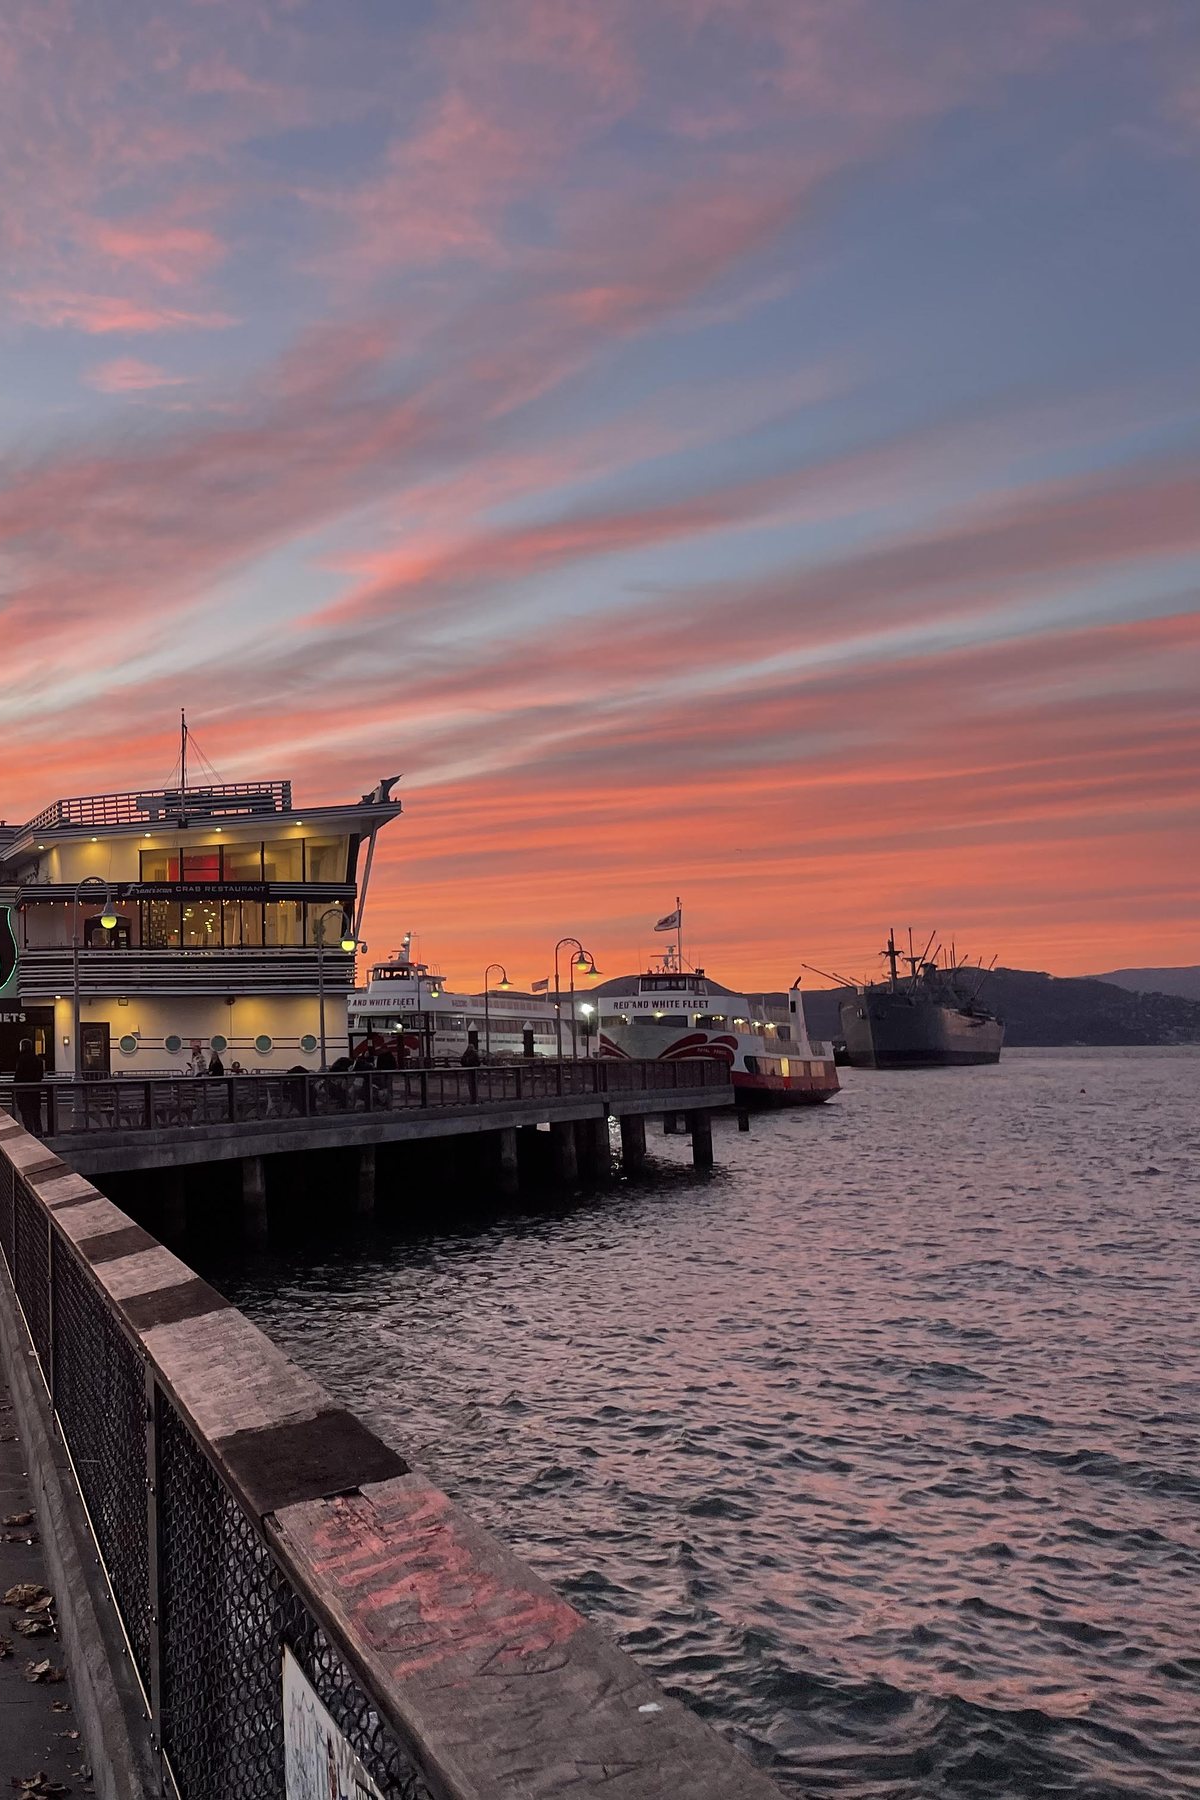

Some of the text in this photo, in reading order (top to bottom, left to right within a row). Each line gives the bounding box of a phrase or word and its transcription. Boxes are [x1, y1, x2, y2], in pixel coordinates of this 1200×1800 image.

[122, 883, 173, 897] Franciscan
[393, 998, 415, 1006] FLEET
[614, 1000, 709, 1010] RED AND WHITE FLEET
